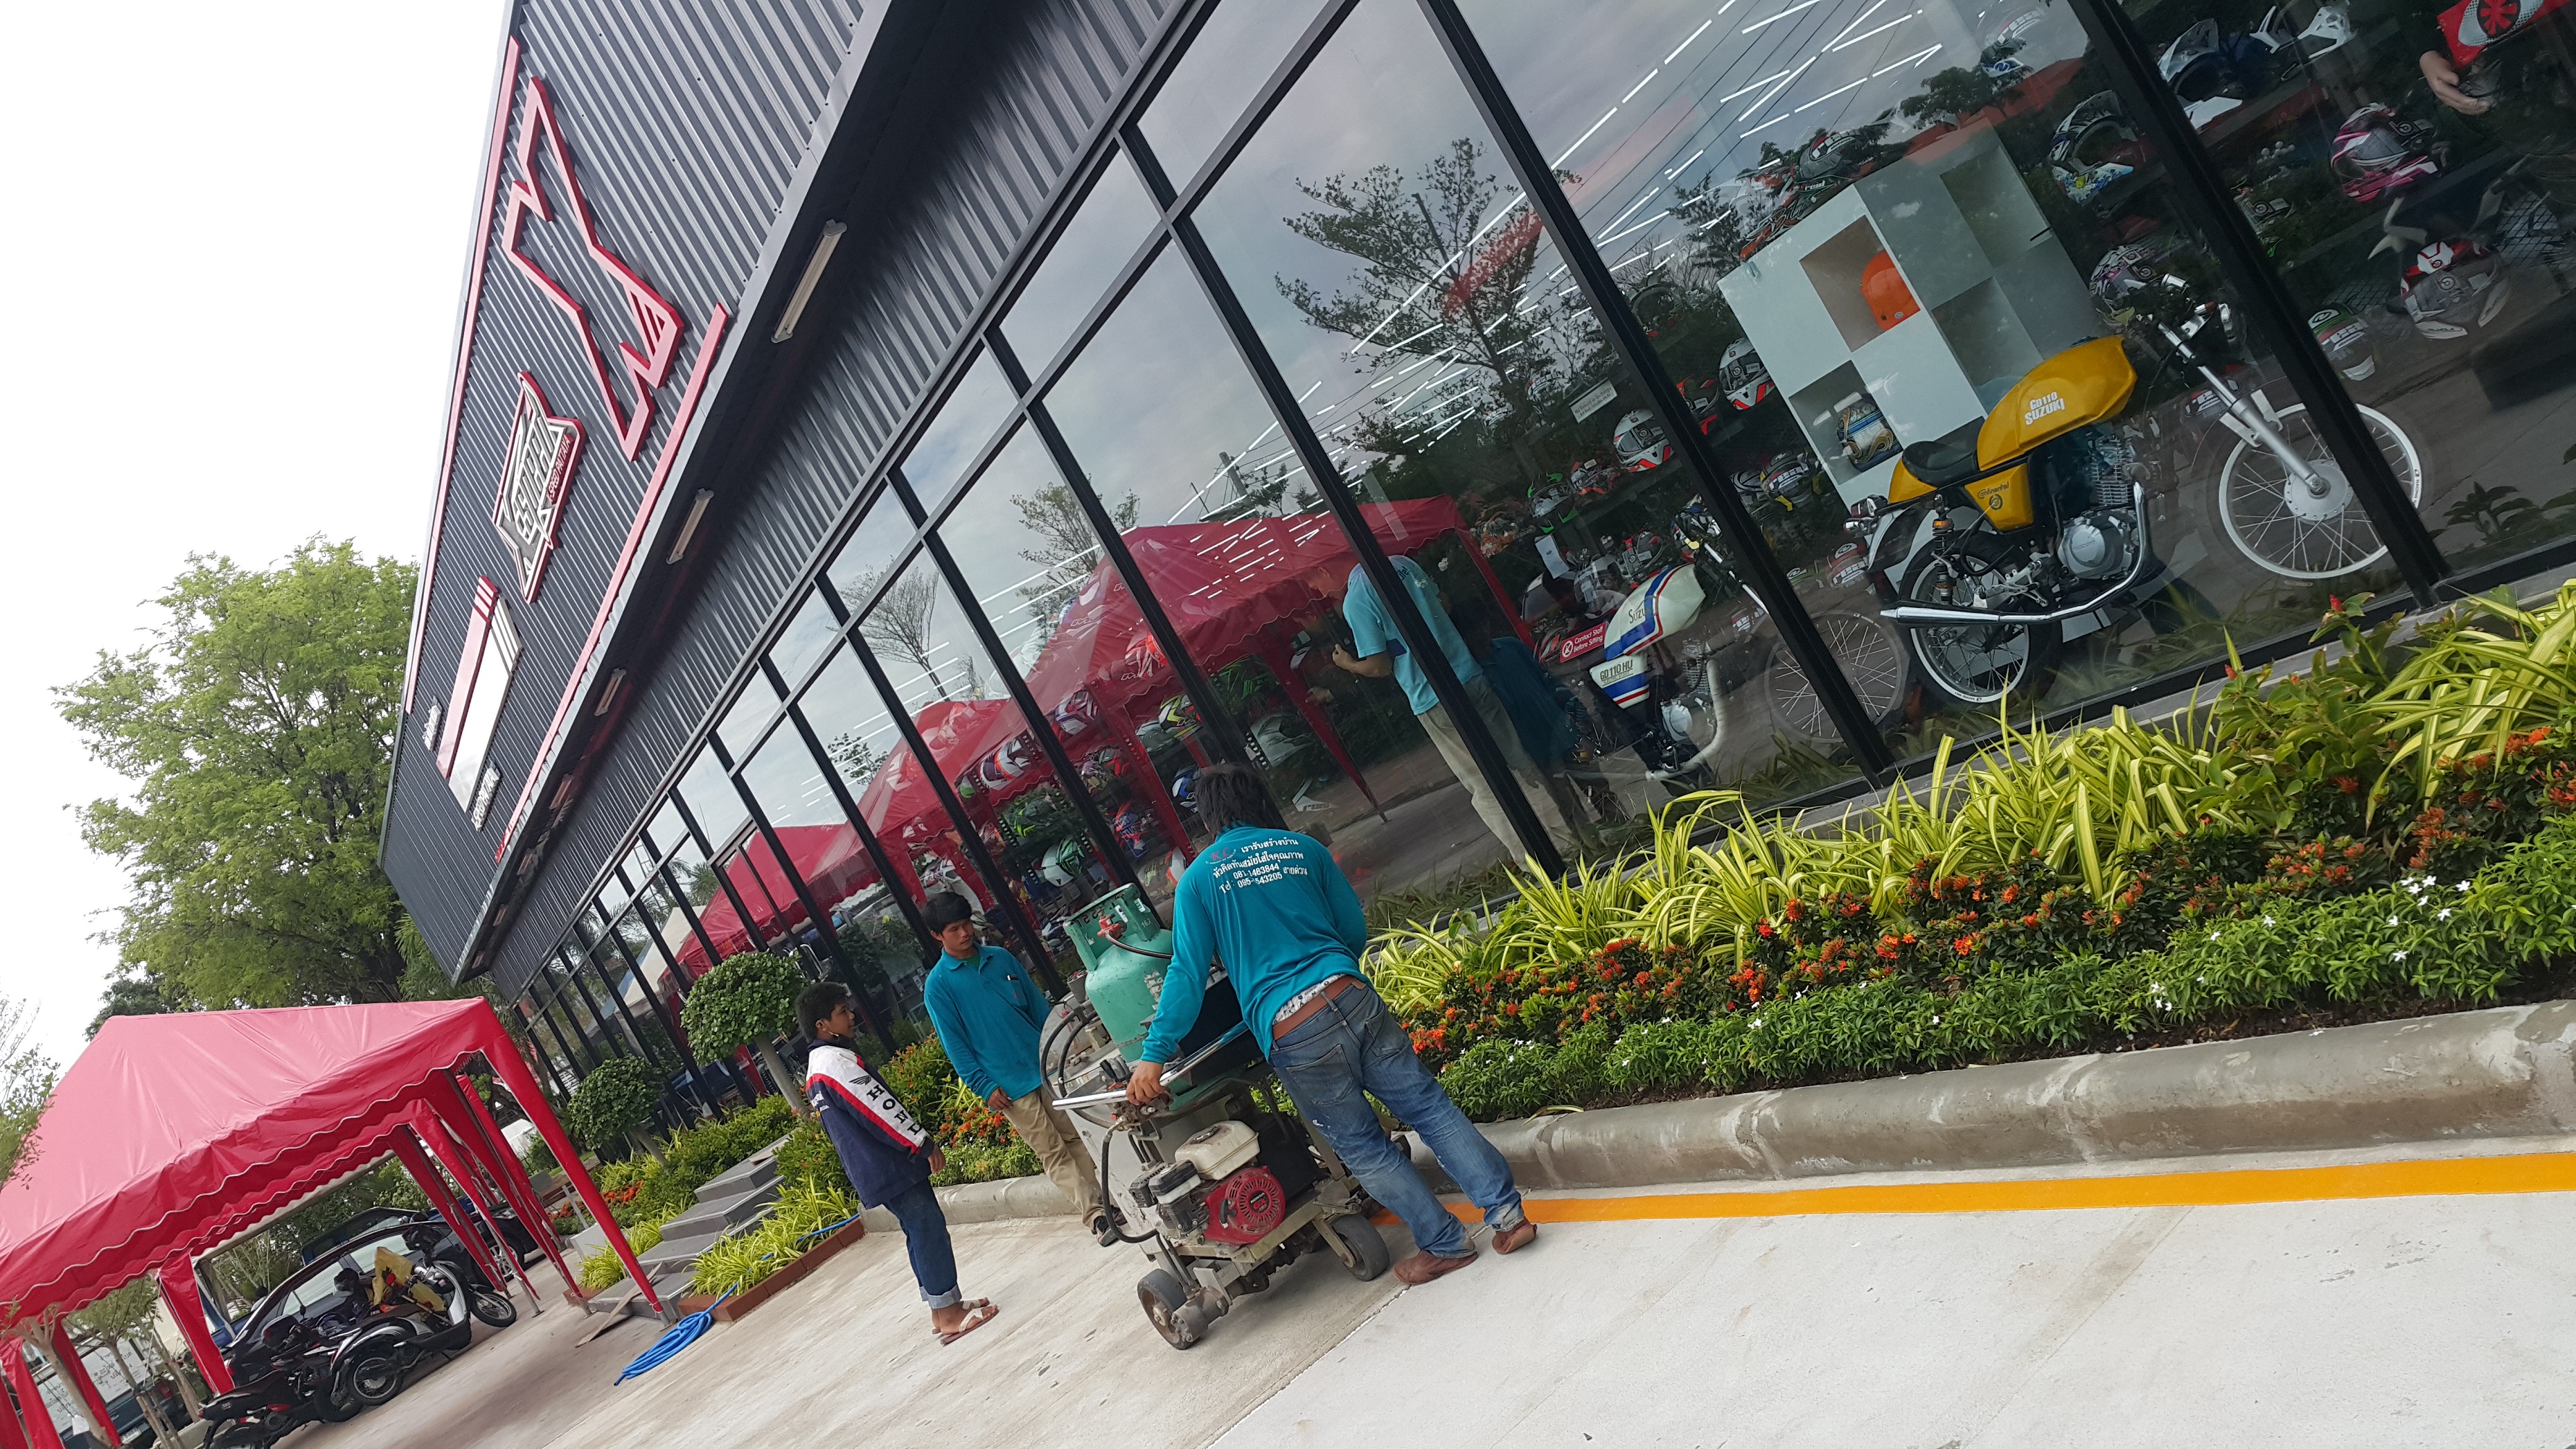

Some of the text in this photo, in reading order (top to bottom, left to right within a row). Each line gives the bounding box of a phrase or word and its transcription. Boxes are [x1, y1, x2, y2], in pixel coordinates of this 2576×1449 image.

[2025, 398, 2065, 426] SUZUKI
[556, 434, 571, 471] PATTAYA
[1573, 634, 1604, 653] Before Sitting
[1574, 625, 1604, 644] Contact Staff
[1600, 659, 1633, 680] GD 110 HU
[1241, 836, 1299, 853] เรารับสร้างบ้าน
[1283, 864, 1308, 875] สายด่วน
